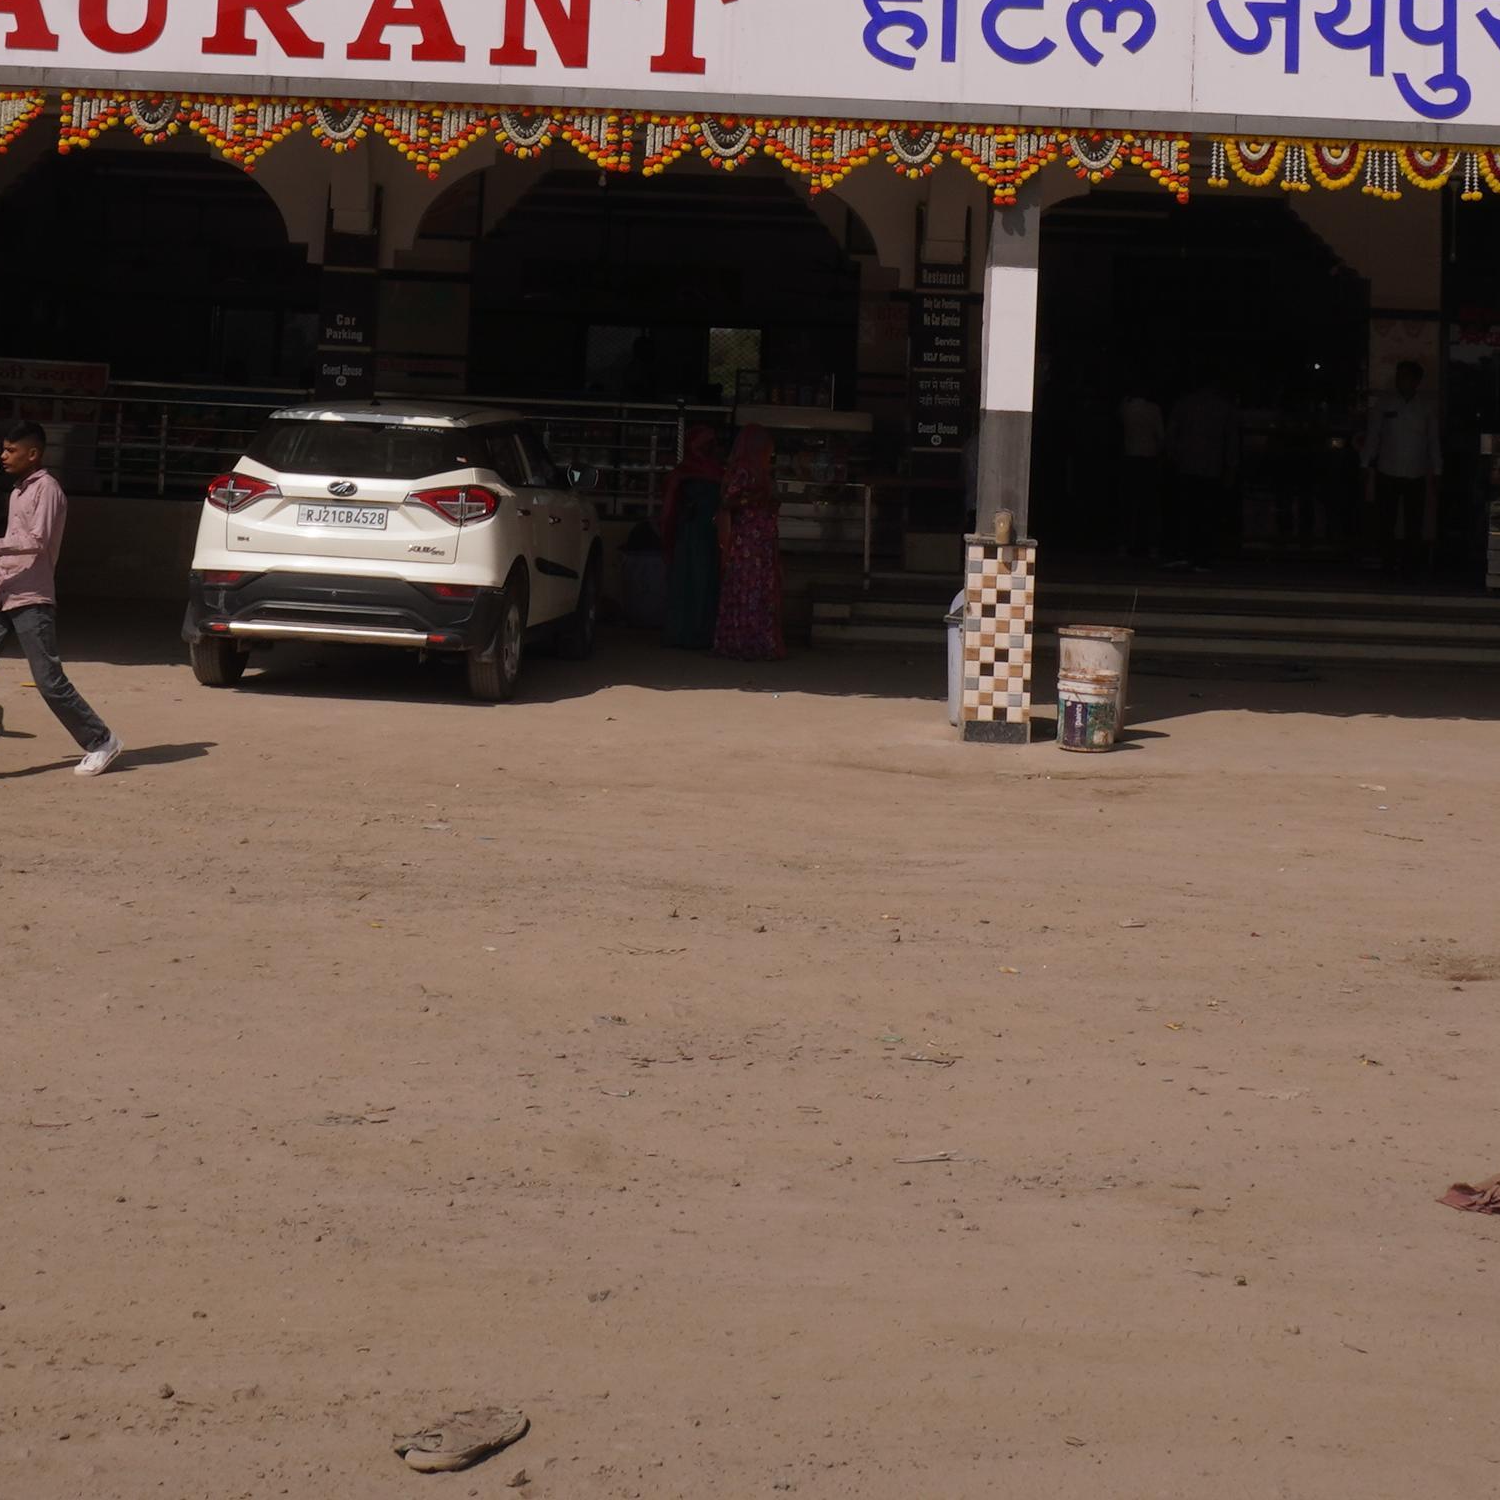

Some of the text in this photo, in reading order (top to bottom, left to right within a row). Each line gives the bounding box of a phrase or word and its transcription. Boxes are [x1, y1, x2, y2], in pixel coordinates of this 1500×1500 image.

[921, 268, 965, 286] Restaurant
[336, 313, 357, 326] Car
[326, 328, 363, 342] Parking
[342, 365, 363, 377] House
[938, 423, 959, 435] House
[306, 508, 385, 526] RJ21CB4528
